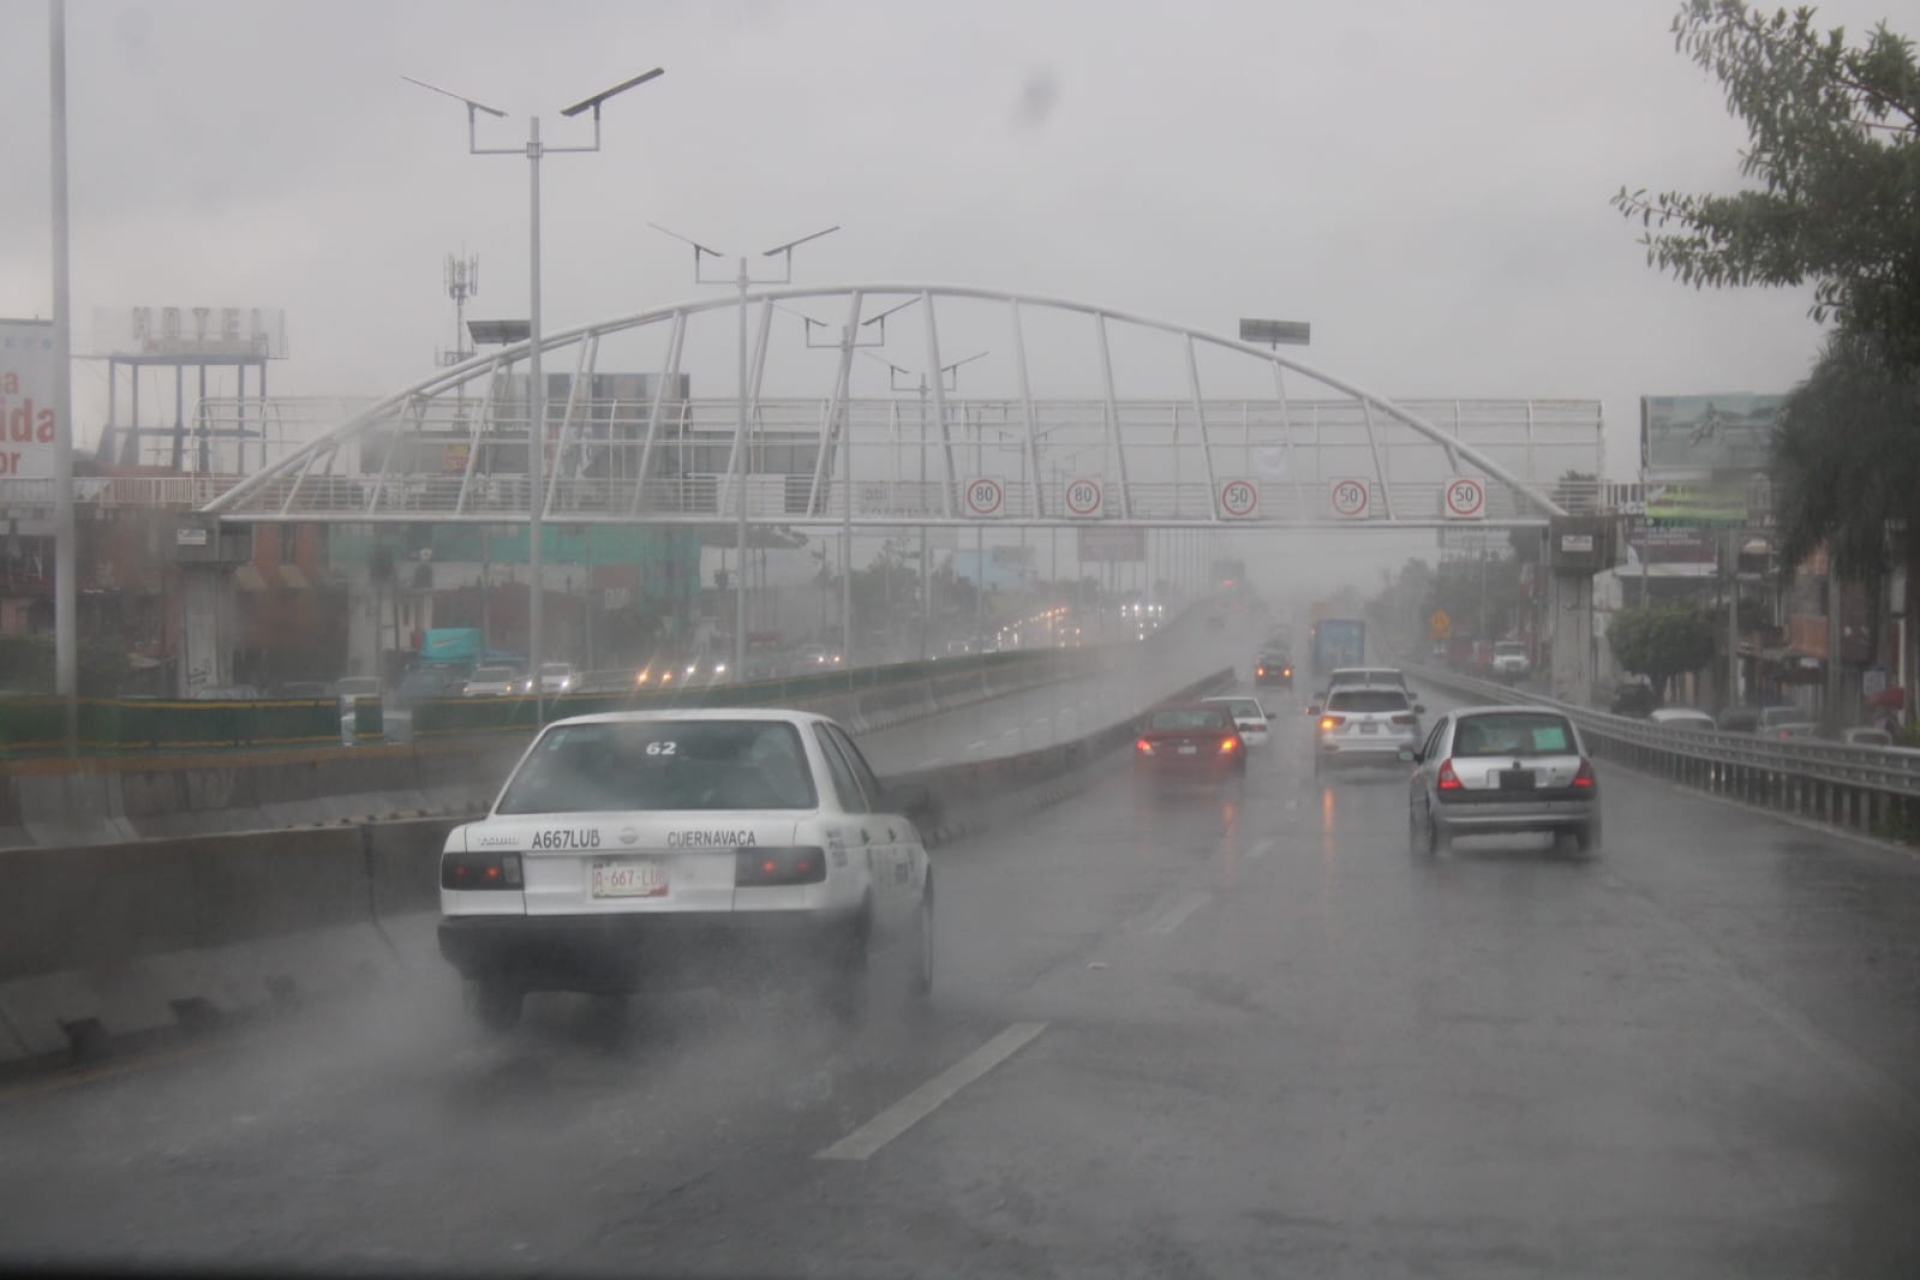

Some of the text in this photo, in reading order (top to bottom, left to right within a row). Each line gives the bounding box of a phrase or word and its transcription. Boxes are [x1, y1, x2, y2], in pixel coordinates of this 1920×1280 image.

[975, 486, 994, 502] 80
[1075, 487, 1093, 503] 80
[1229, 487, 1248, 503] 50
[1339, 487, 1358, 503] 50
[1455, 485, 1474, 502] 50
[646, 741, 676, 755] 62
[531, 831, 601, 849] A667LUB
[667, 832, 756, 848] CUERNAVACA
